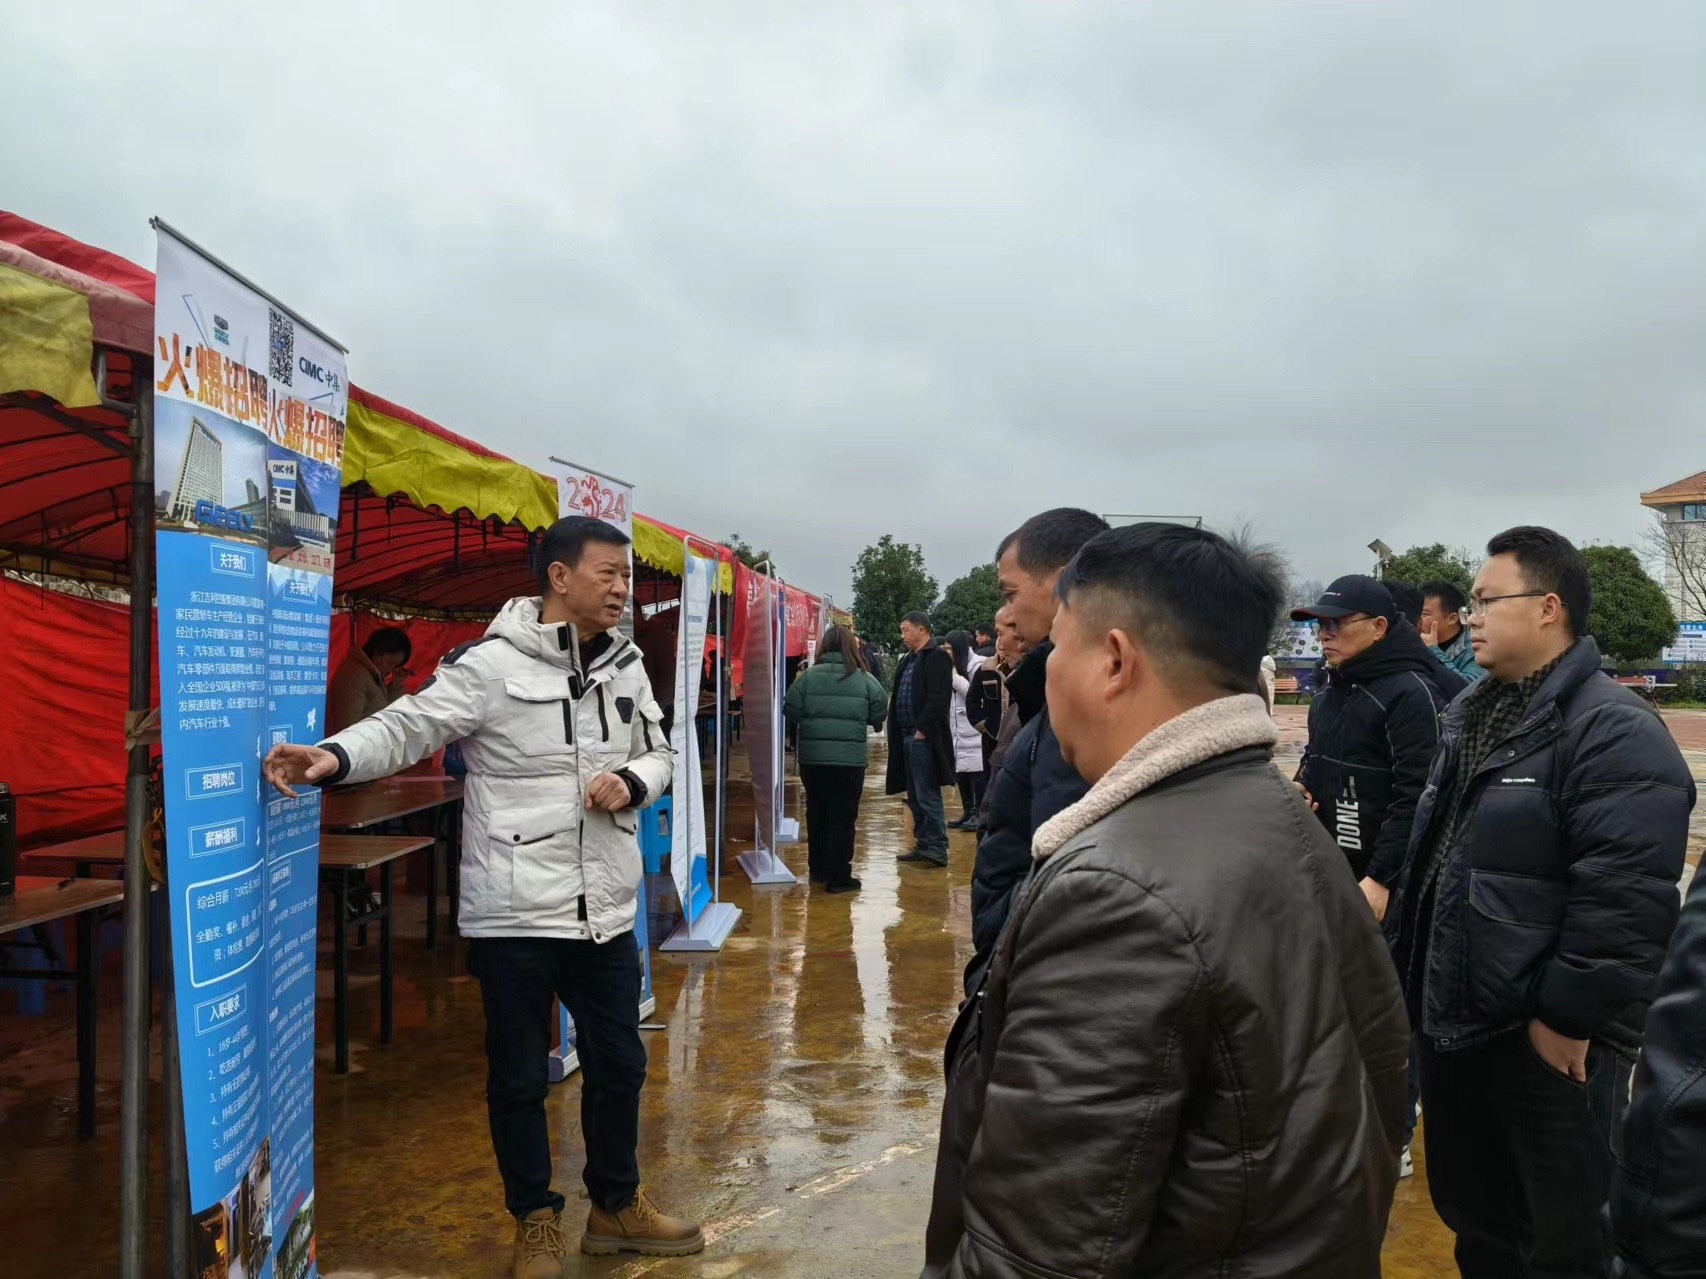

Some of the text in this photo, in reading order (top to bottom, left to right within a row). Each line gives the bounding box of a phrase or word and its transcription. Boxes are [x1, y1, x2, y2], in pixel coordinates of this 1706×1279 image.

[157, 333, 268, 429] 火爆招聘
[299, 356, 341, 392] CIMC 中集
[268, 389, 345, 469] 火爆招聘
[194, 499, 253, 532] GEELY
[220, 551, 247, 571] 关于我们
[289, 580, 311, 597] 关于我们
[202, 770, 236, 790] 招聘岗位
[205, 826, 238, 848] 薪酬福利
[1336, 799, 1362, 850] DONE
[209, 993, 240, 1022] 入职要求
